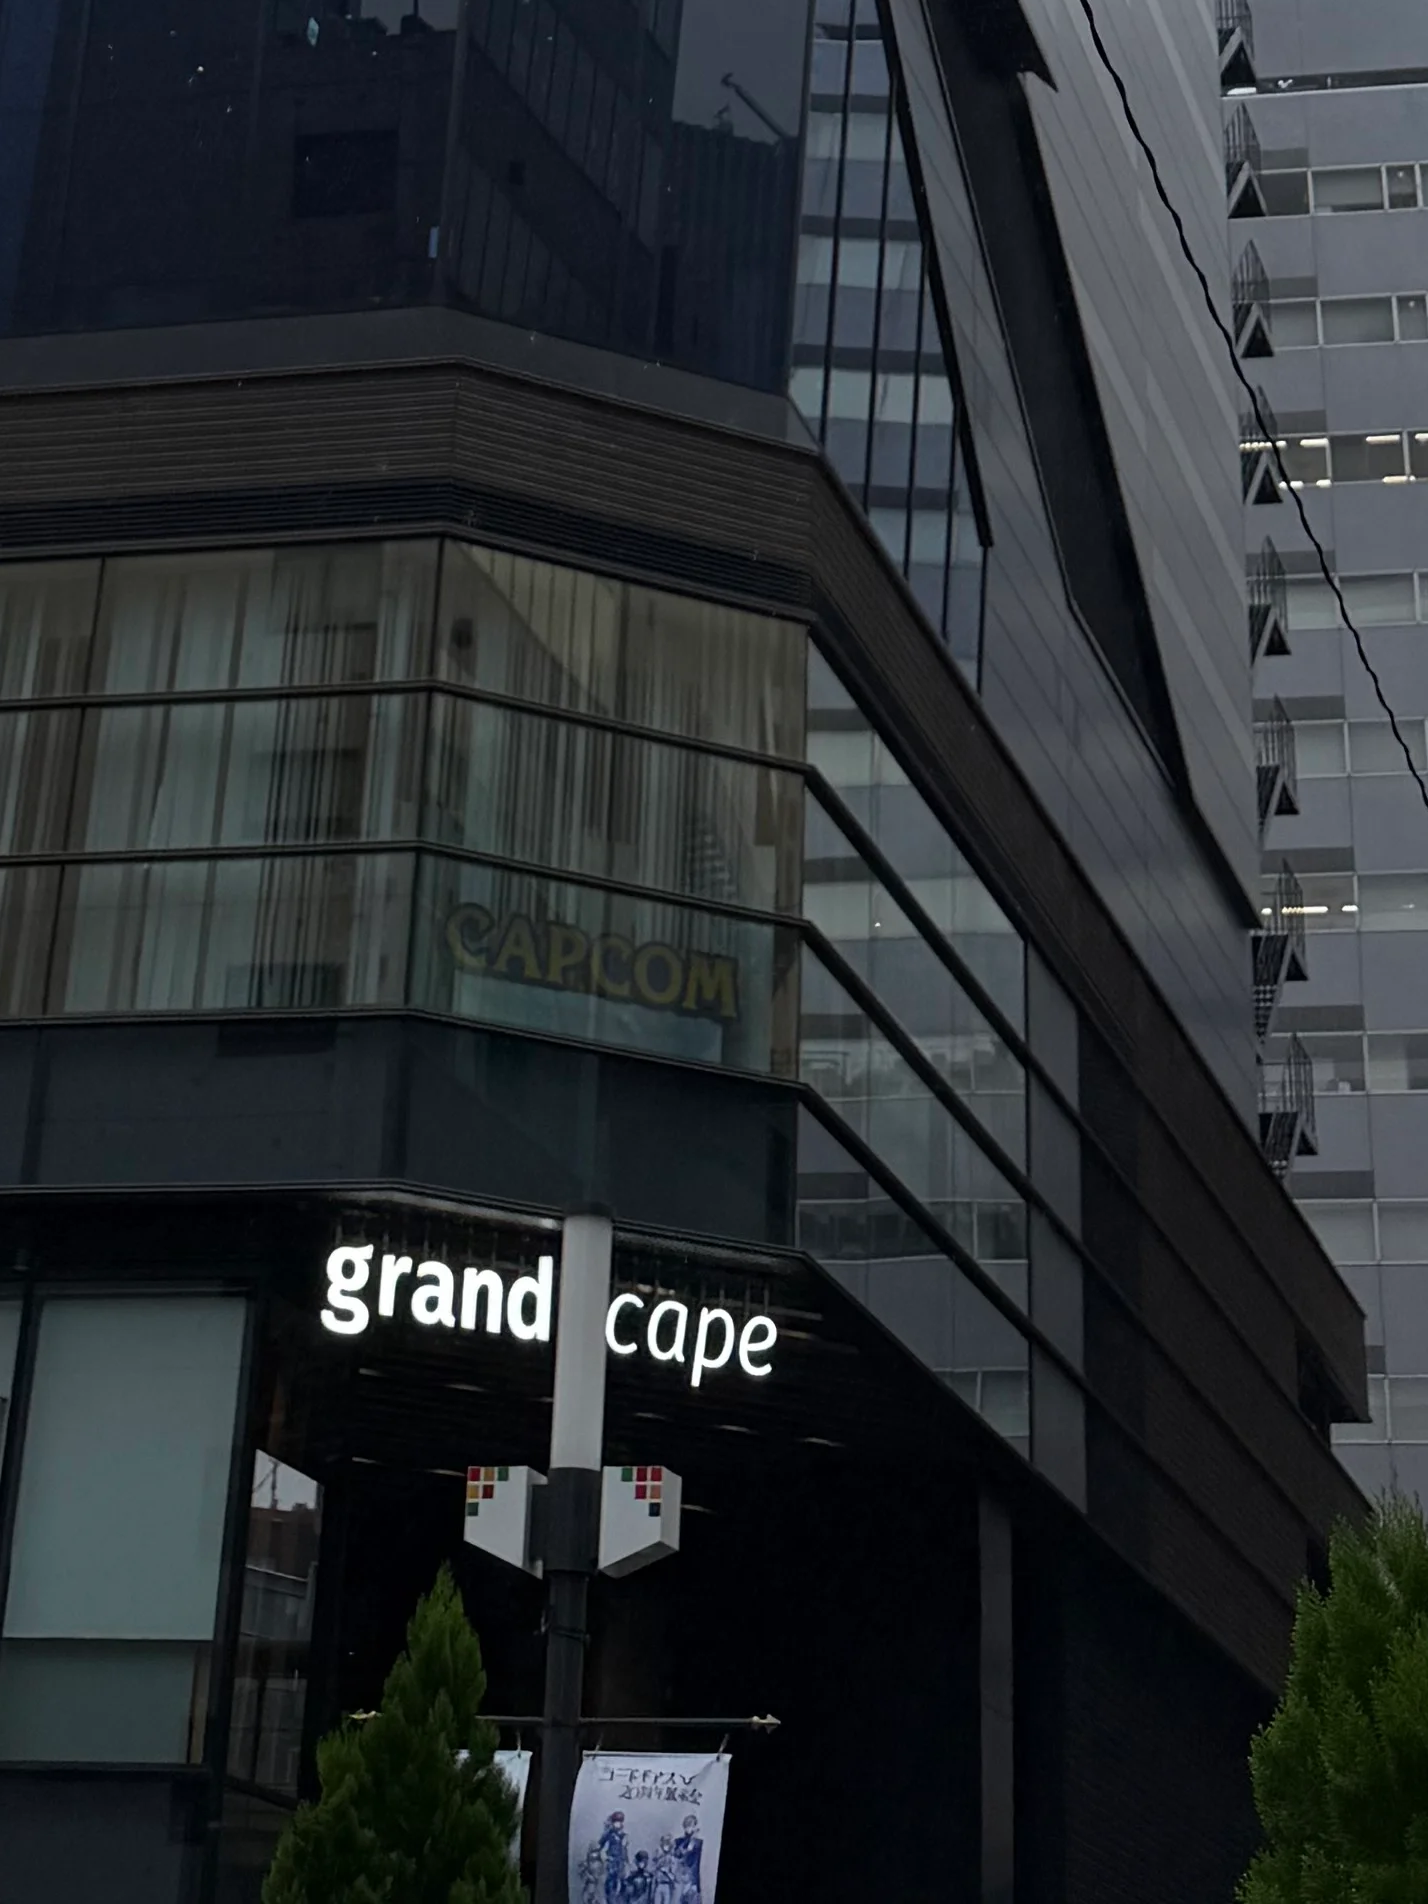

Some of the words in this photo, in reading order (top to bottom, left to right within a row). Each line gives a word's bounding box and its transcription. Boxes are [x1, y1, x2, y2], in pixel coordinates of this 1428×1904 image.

[443, 902, 740, 1020] CAPCOM
[319, 1243, 554, 1343] grand
[603, 1290, 779, 1387] cape
